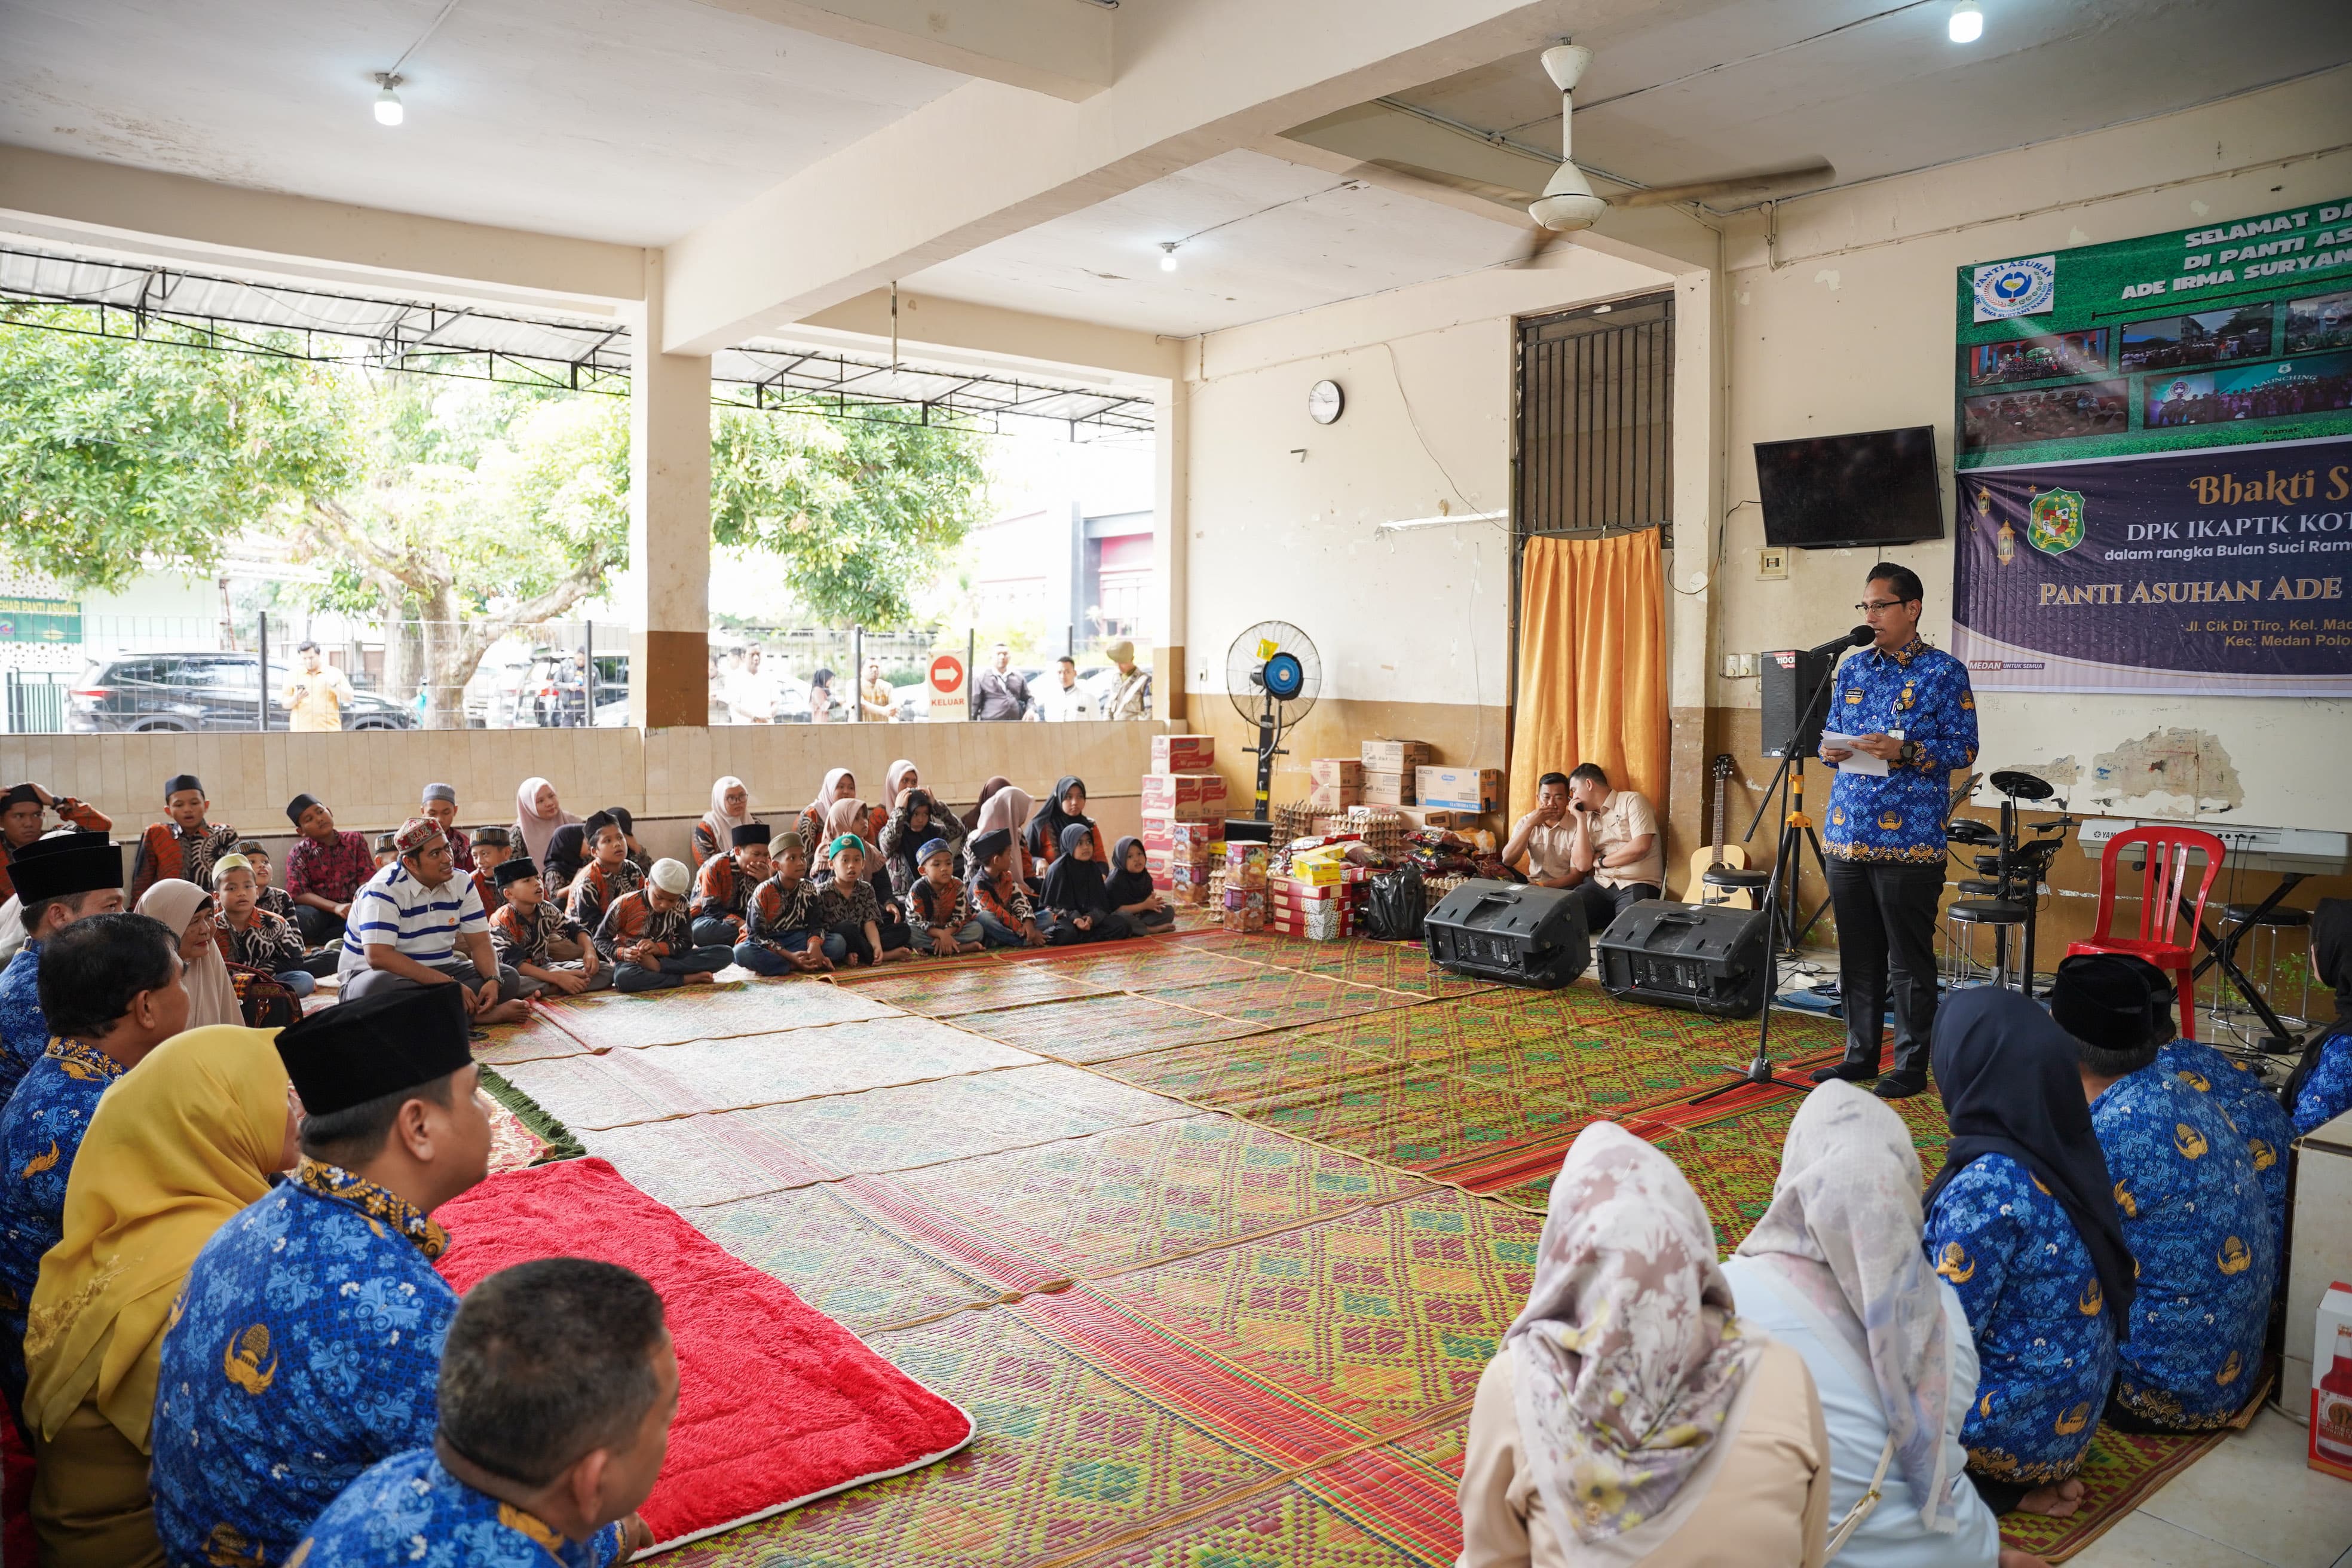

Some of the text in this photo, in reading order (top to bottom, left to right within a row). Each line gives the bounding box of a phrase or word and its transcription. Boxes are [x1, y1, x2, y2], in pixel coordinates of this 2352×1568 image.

[2185, 212, 2308, 247] SELAMAT
[2183, 253, 2212, 270] DI
[2219, 237, 2305, 264] PANTI
[1975, 261, 2054, 288] PANTI ASUHAN
[2121, 248, 2352, 299] ADE IRMA SURYAN
[1980, 307, 1996, 317] IRMA
[2031, 282, 2053, 309] NASUTION
[2190, 470, 2314, 506] Bhakti
[2127, 522, 2179, 541] DPK
[2188, 516, 2290, 538] IKAPTK
[2105, 540, 2352, 562] dalam rangka Bulan Suci Ram
[2038, 575, 2343, 605] PANTI ASUHAN ADE
[2185, 621, 2201, 632] Jl.
[2206, 620, 2229, 632] Cik
[2233, 620, 2248, 632] Di
[2252, 620, 2285, 633] Tiro,
[2289, 619, 2317, 631] Kel.
[2225, 634, 2352, 647] Kec. Medan Polo
